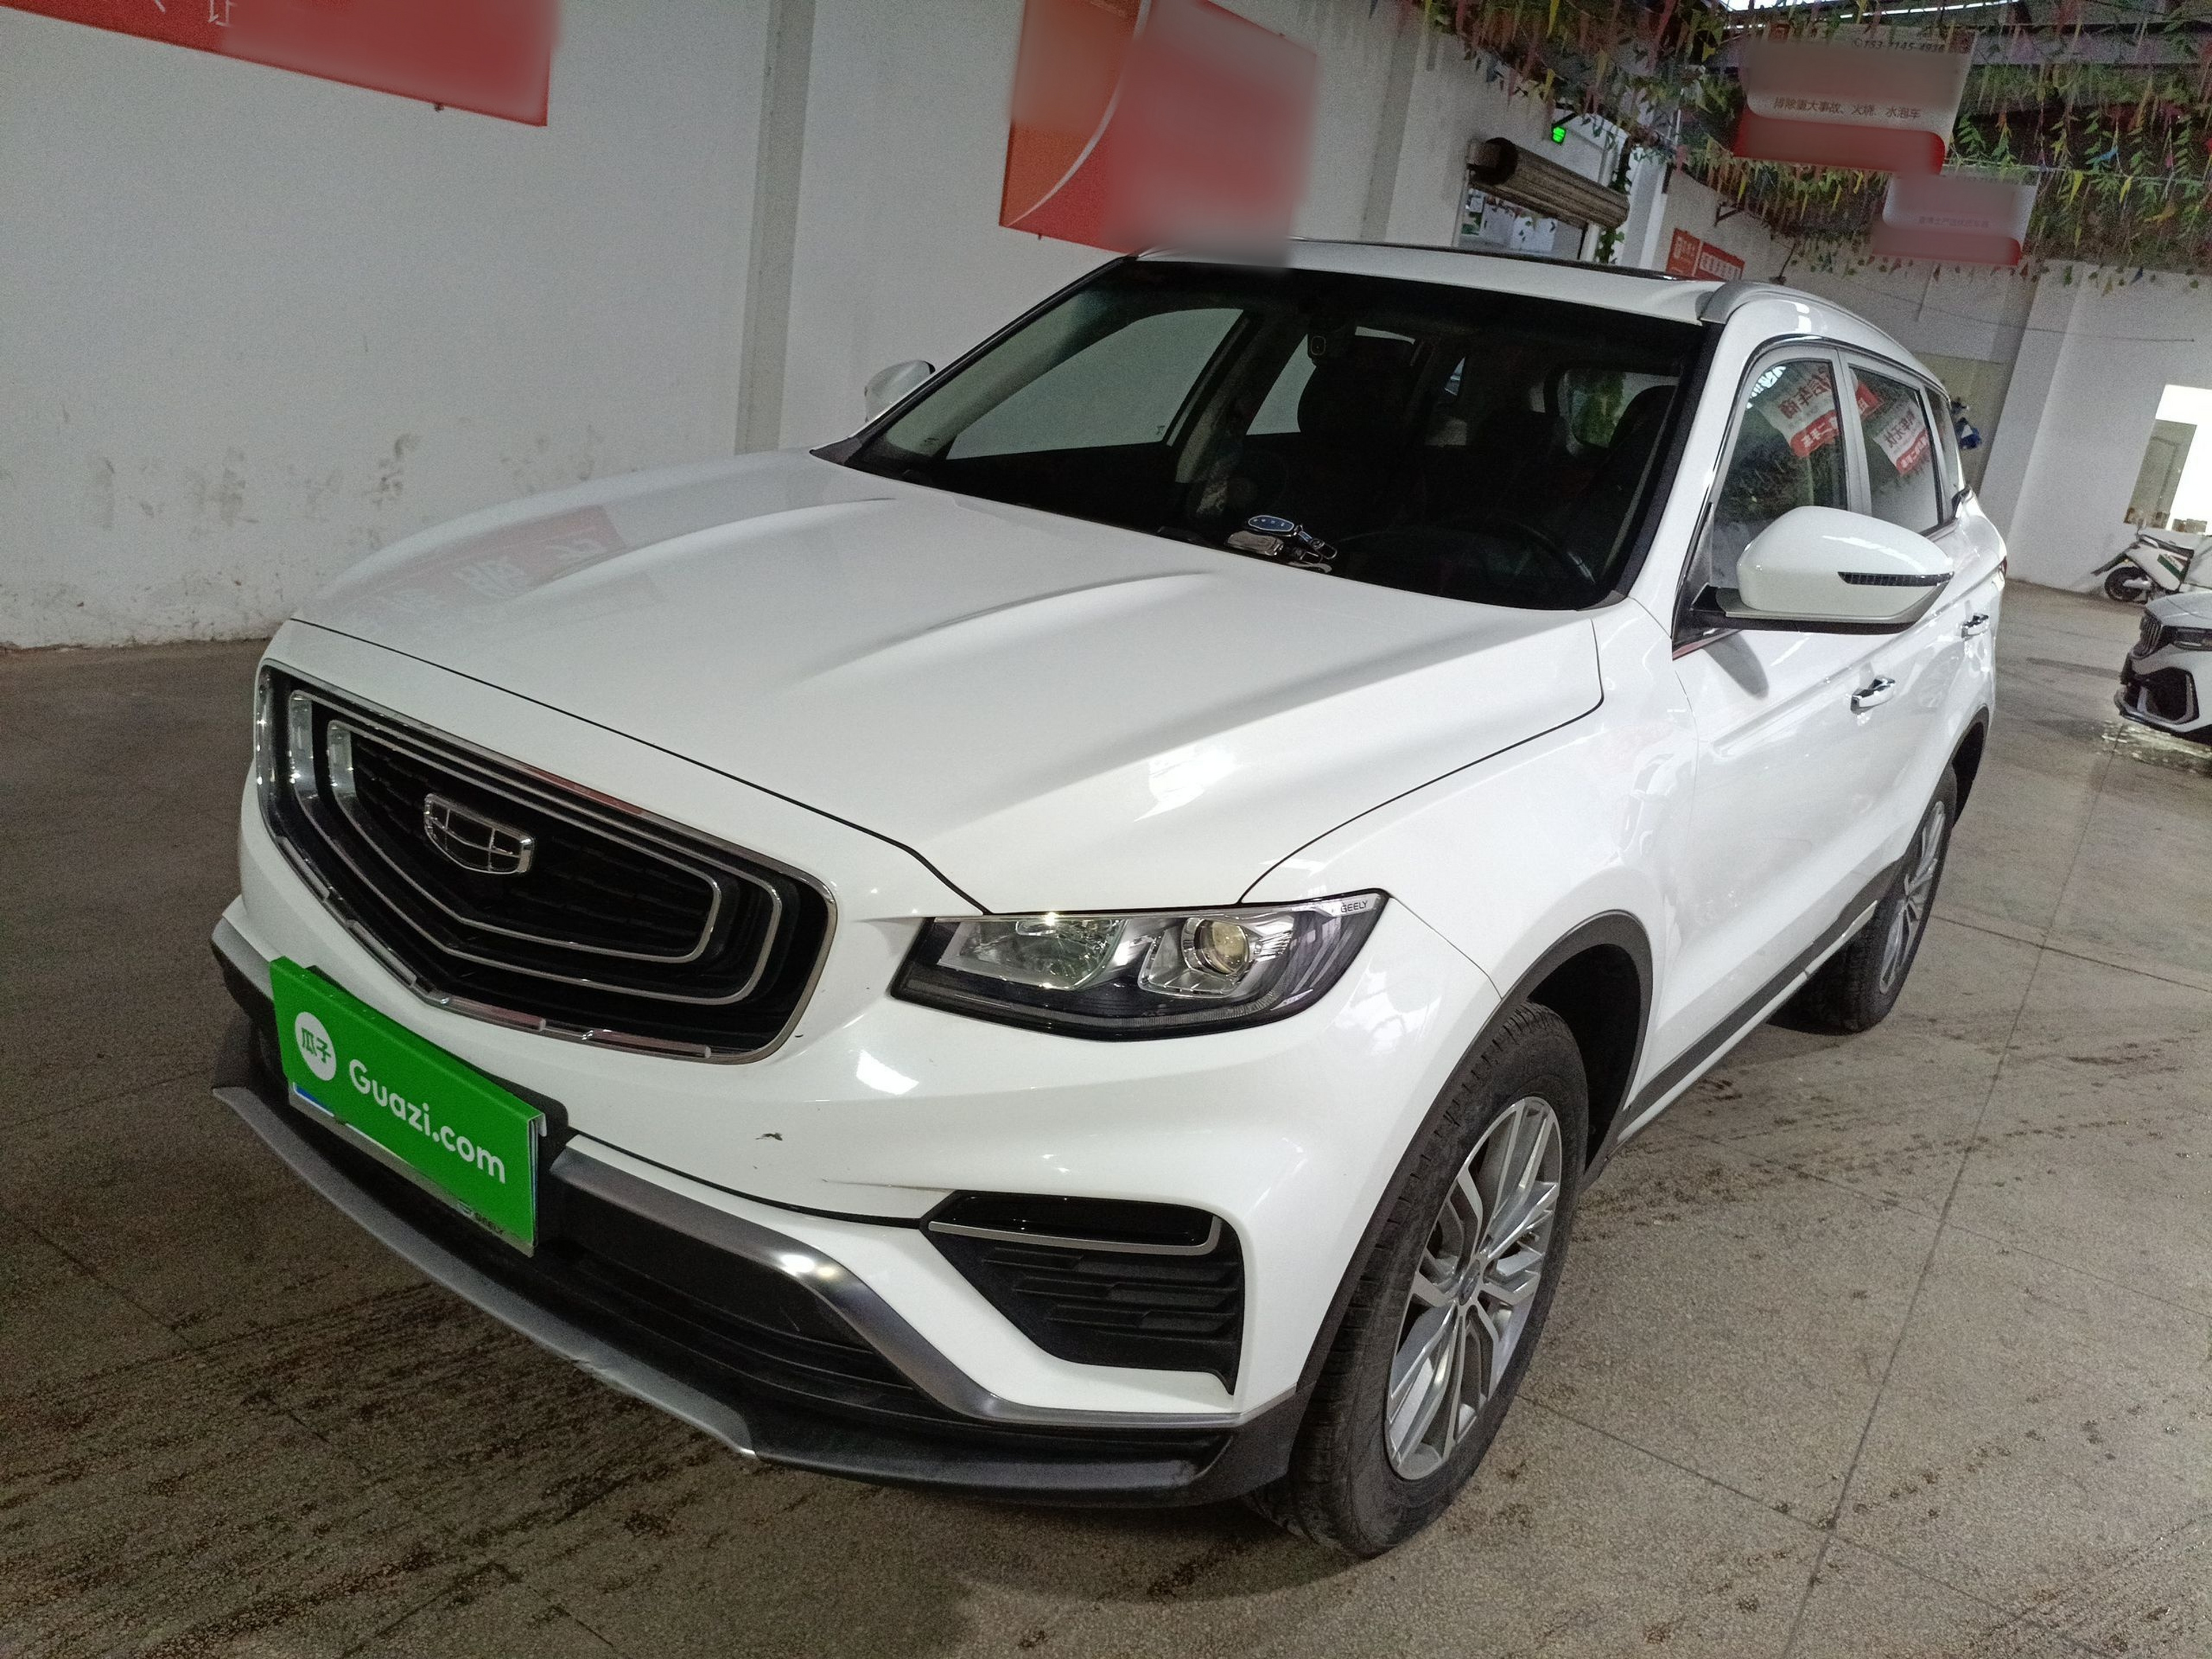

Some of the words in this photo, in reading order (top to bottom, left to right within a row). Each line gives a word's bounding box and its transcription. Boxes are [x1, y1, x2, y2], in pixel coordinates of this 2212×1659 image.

[1340, 900, 1368, 912] GEELY
[301, 1027, 331, 1063] 瓜子
[349, 1059, 506, 1184] Guazi.com
